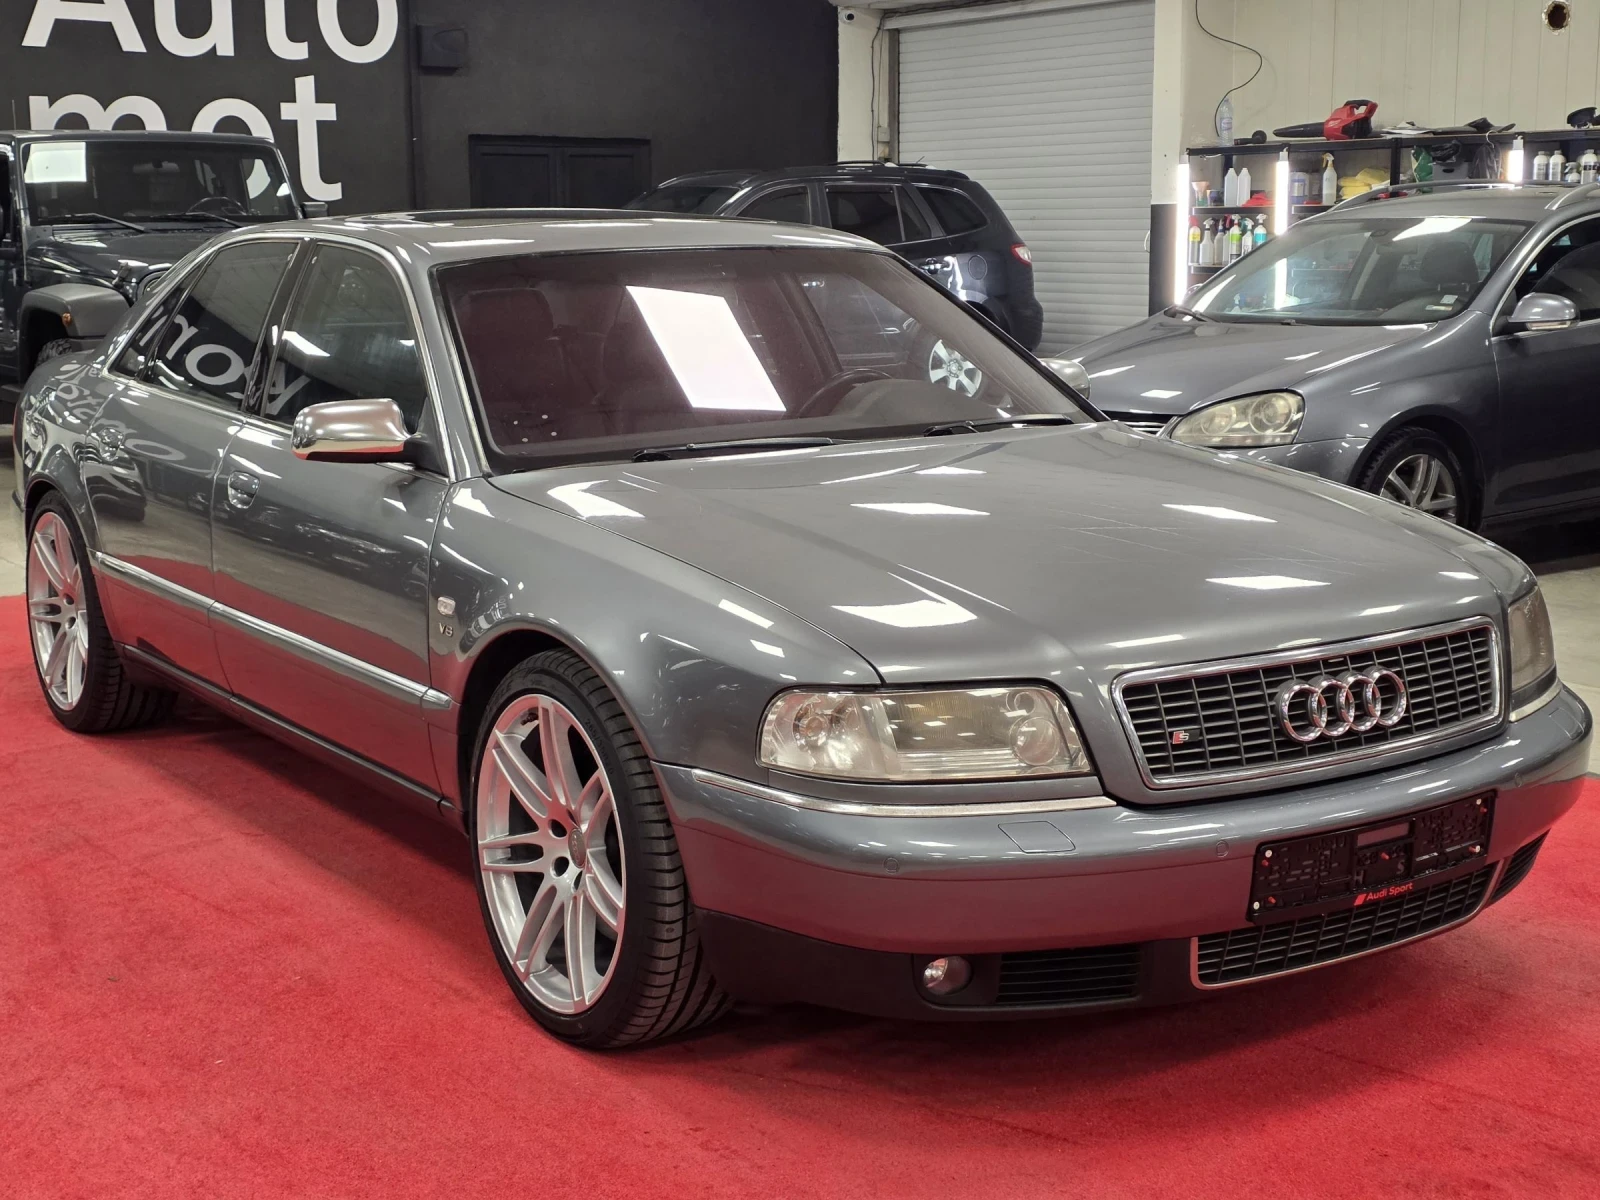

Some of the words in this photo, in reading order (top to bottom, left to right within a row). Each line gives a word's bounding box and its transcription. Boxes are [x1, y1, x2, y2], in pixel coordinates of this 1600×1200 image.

[438, 622, 454, 638] V8
[1366, 888, 1388, 901] Audi
[1388, 882, 1413, 896] Sport
